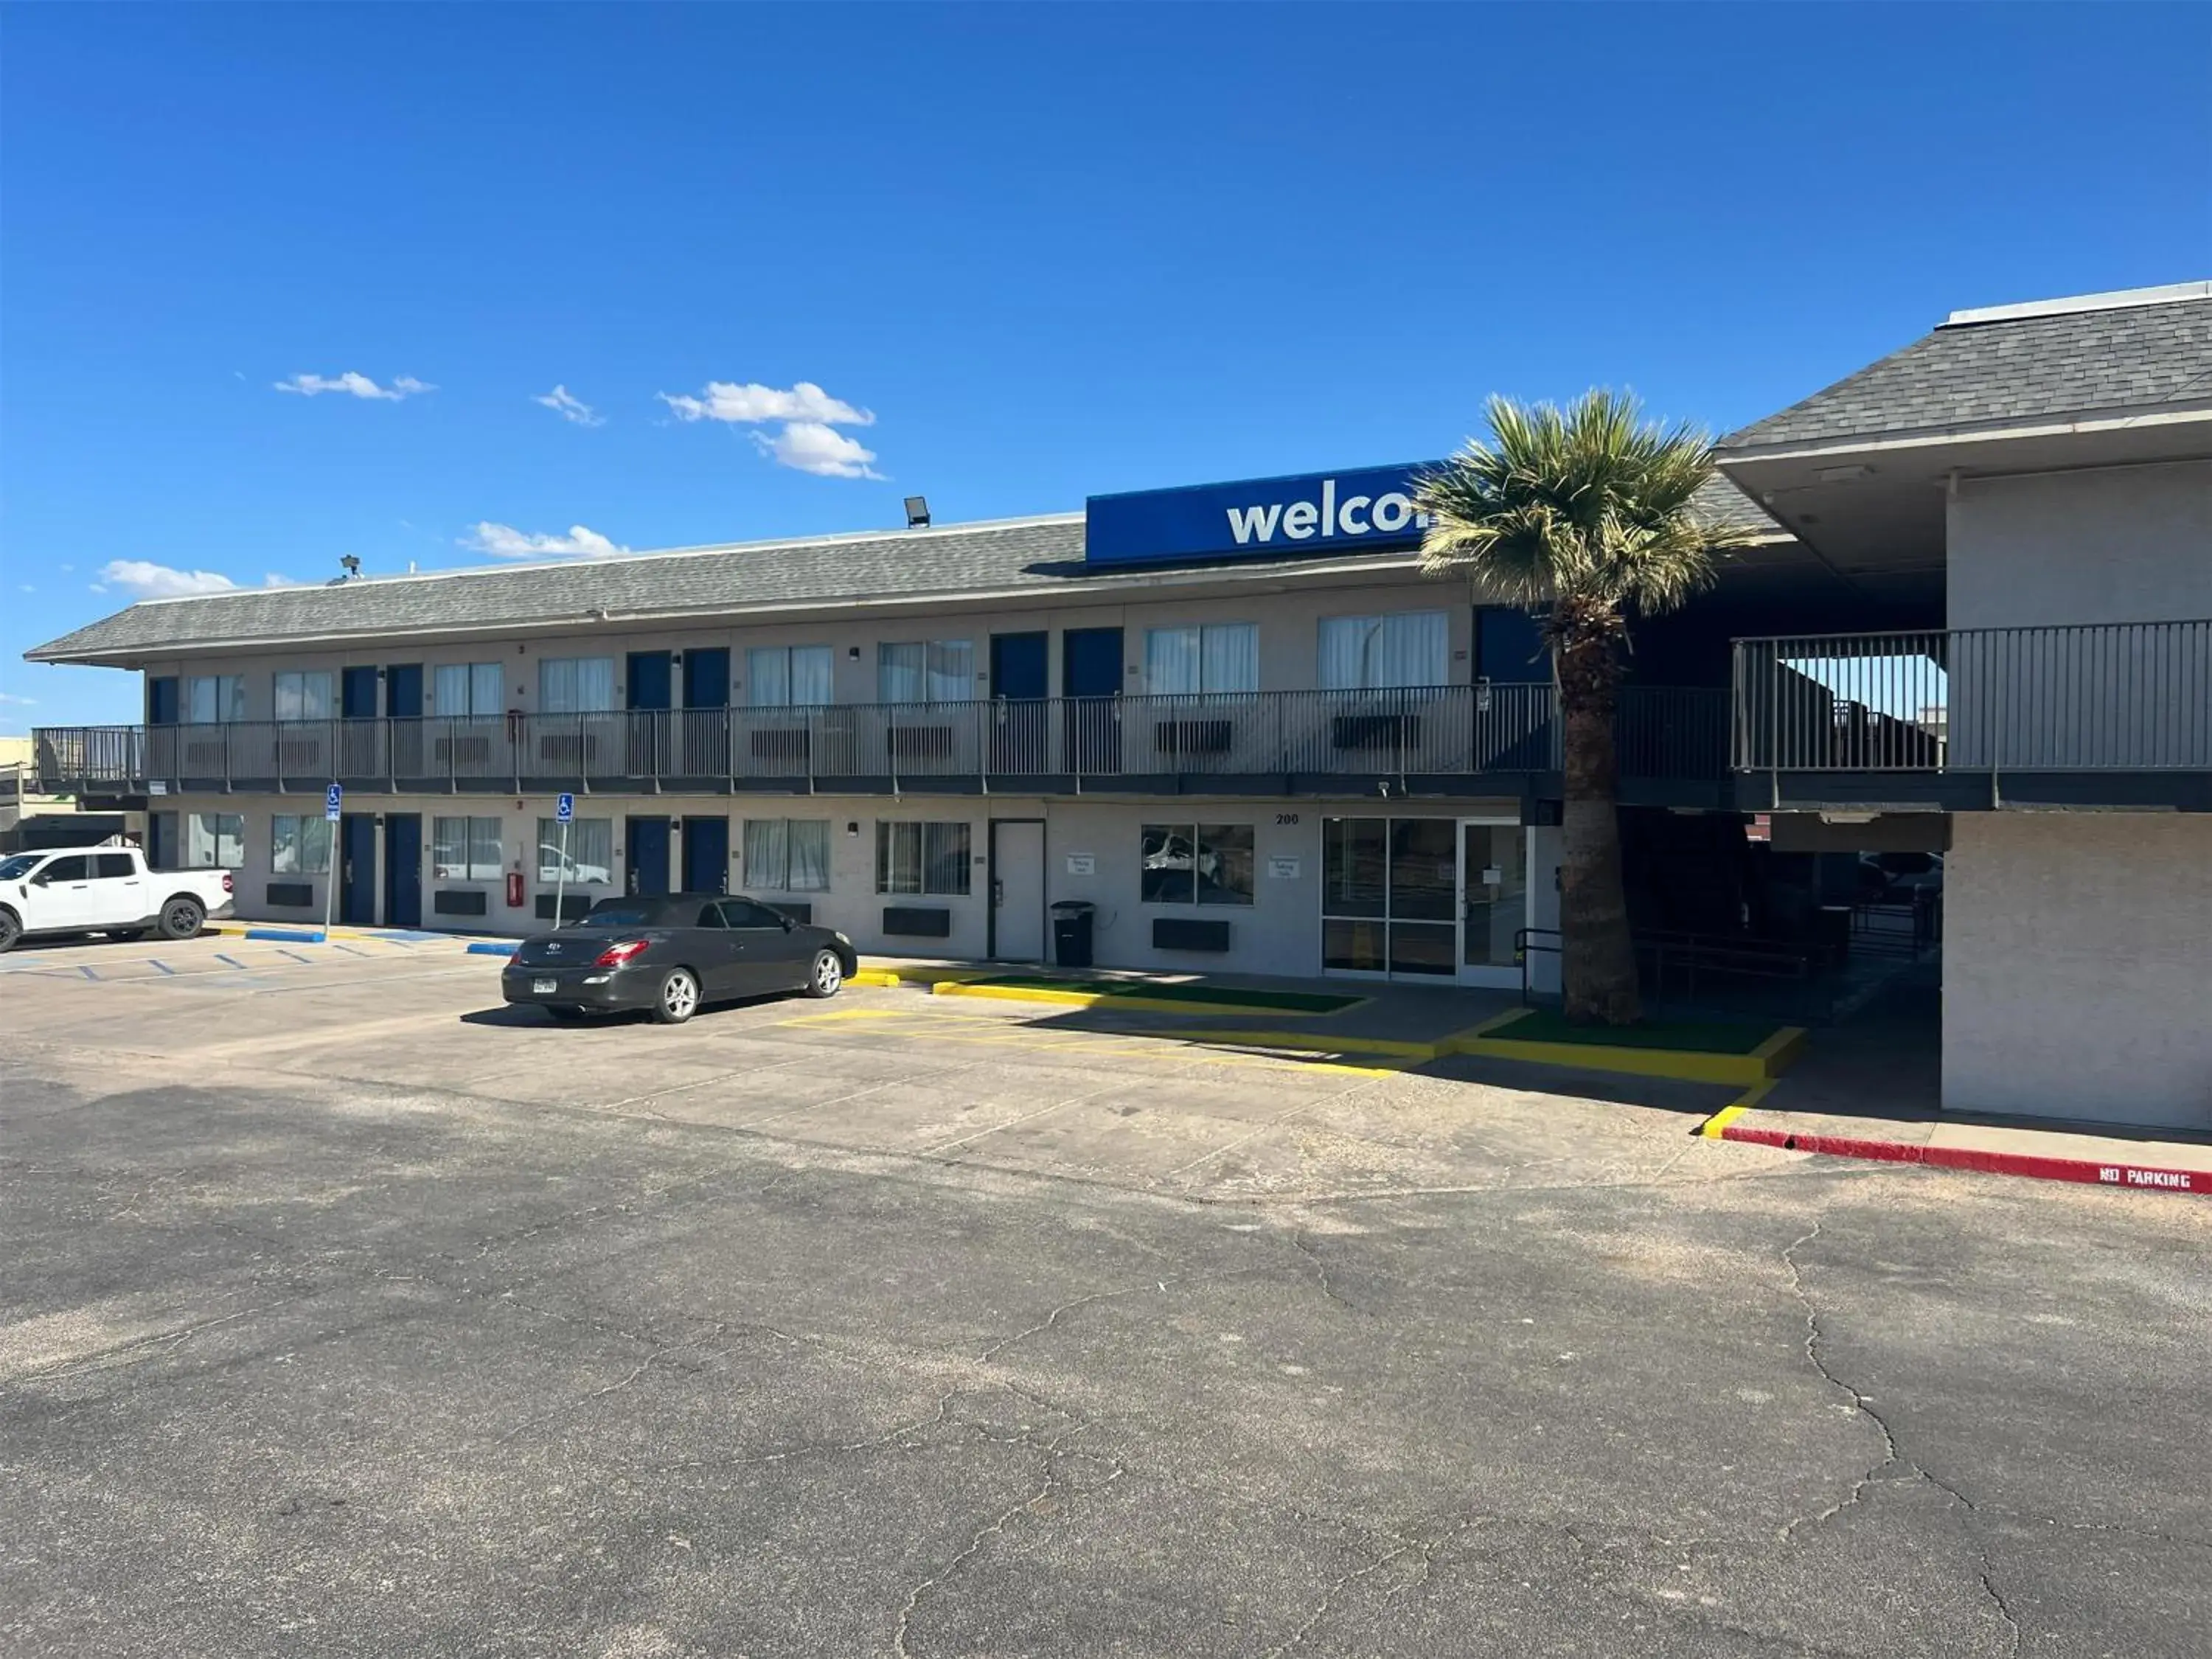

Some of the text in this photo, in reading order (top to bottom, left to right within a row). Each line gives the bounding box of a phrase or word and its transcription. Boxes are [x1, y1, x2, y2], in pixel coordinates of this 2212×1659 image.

[1276, 813, 1298, 825] 200
[2099, 1167, 2191, 1188] NO PARKING
